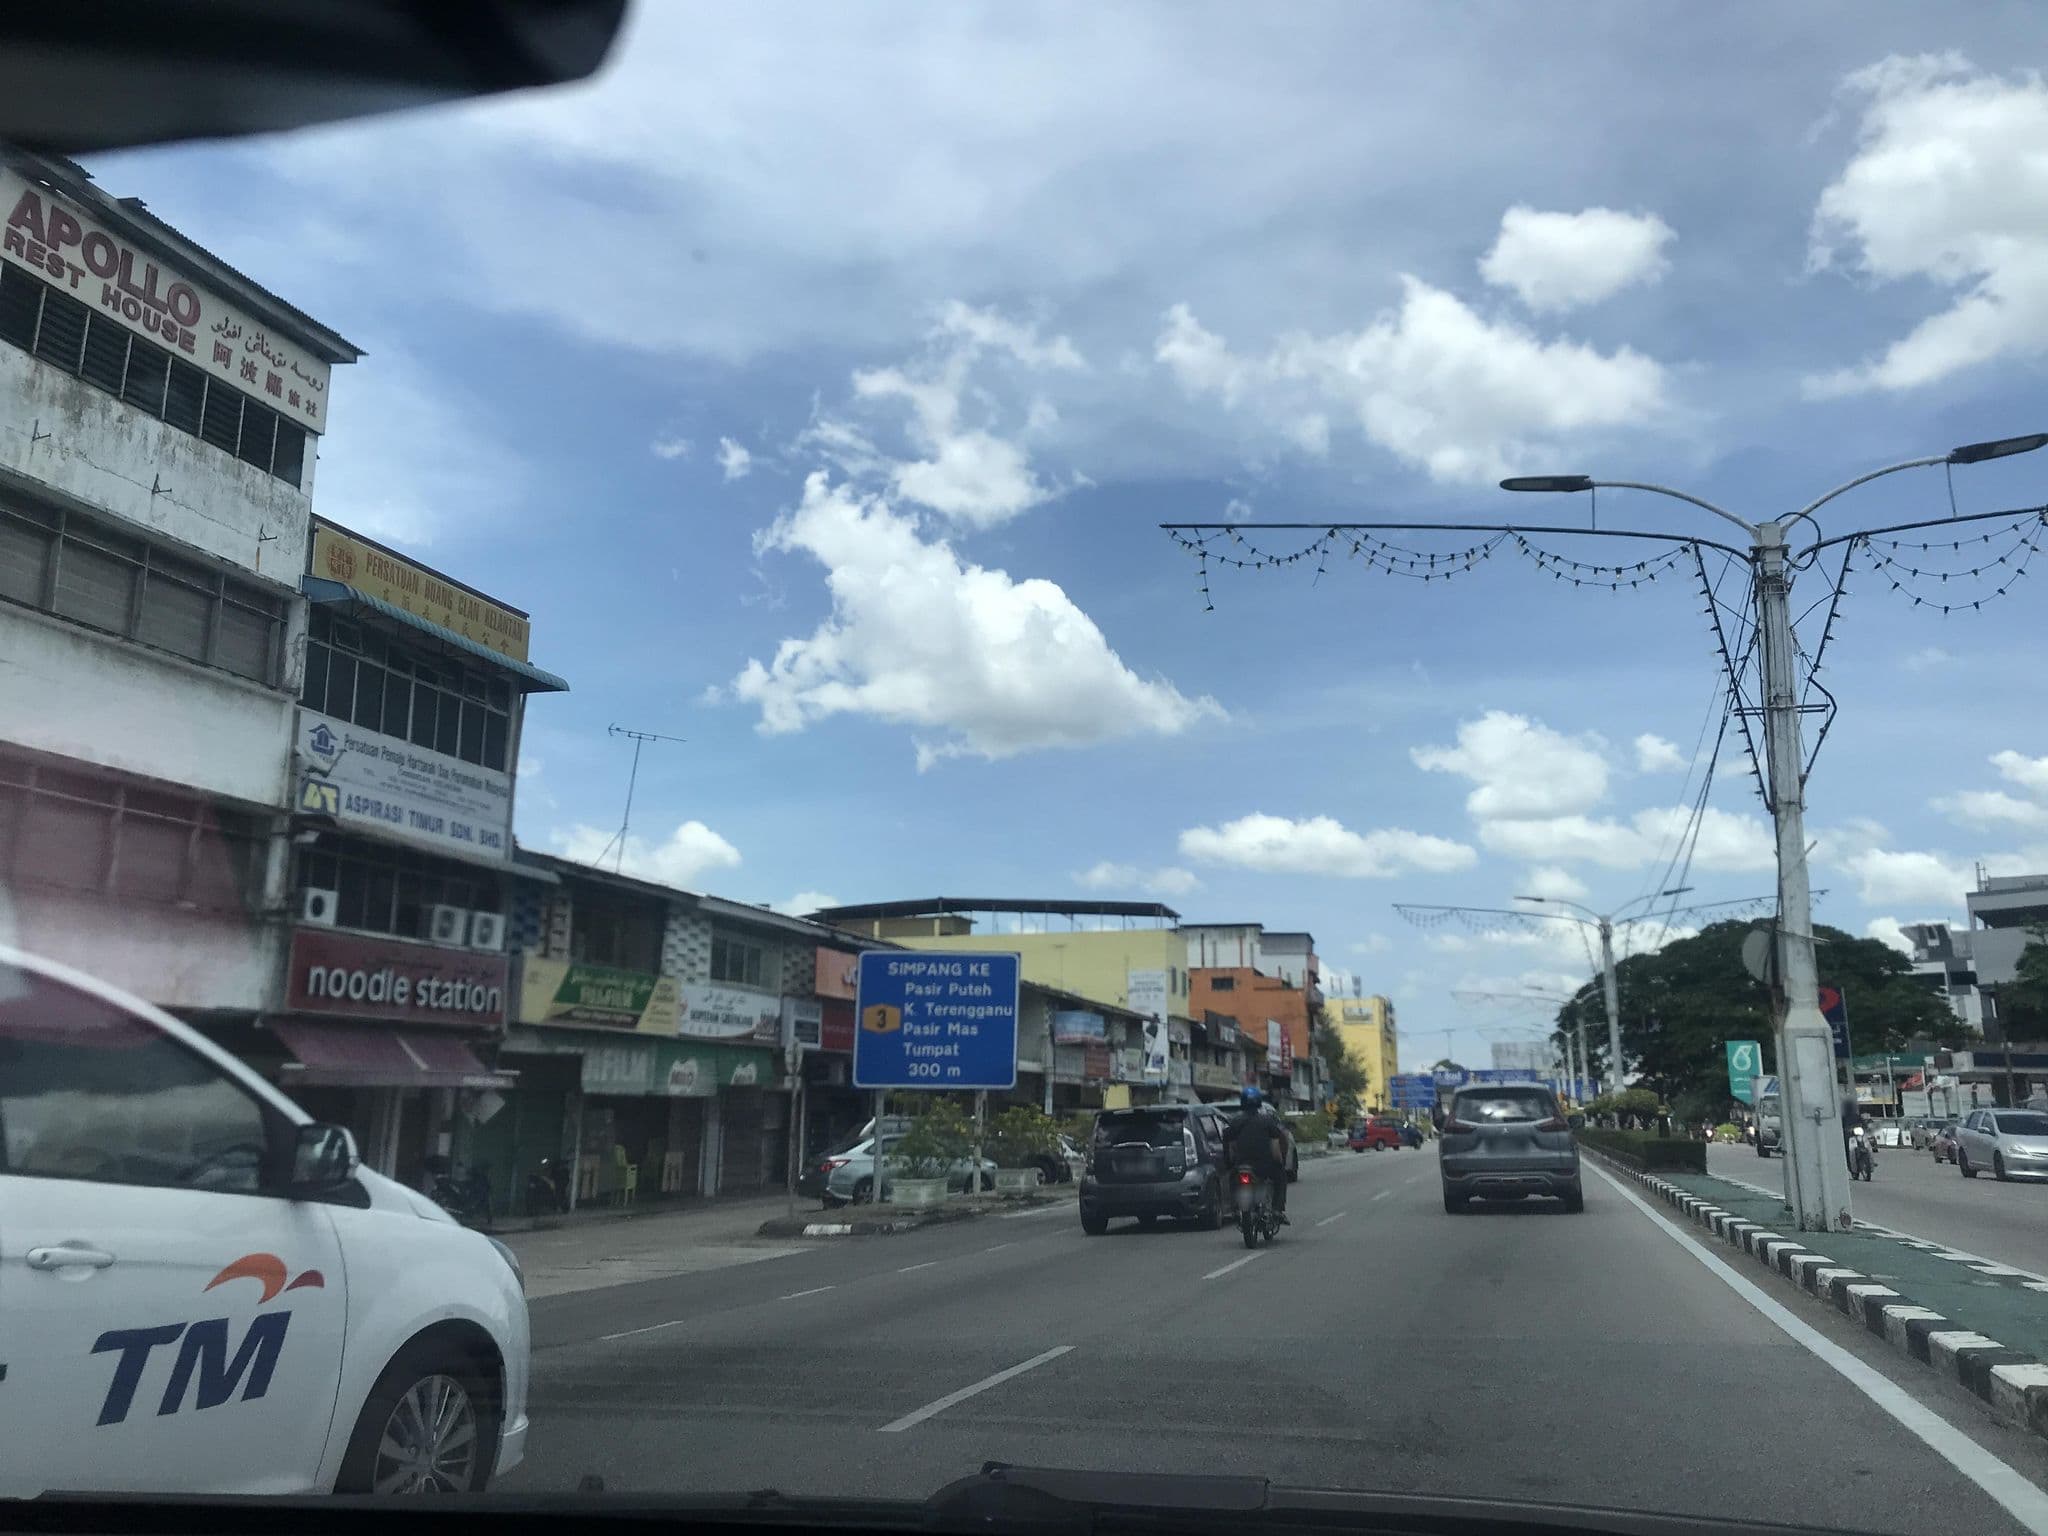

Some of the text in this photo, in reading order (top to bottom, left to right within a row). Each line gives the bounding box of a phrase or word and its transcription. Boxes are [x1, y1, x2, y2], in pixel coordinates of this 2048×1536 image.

[8, 190, 201, 328] APOLLO
[3, 226, 198, 355] REST HOUSE
[366, 552, 420, 595] PERSATUAN
[345, 793, 403, 824] ASPIRASI
[408, 808, 443, 833] TIMUR
[888, 962, 991, 977] SIMPANG KE
[308, 965, 500, 1014] noodle station
[905, 983, 992, 997] Pasir Puteh
[877, 1009, 886, 1029] 3
[925, 1002, 1014, 1019] Terengganu
[903, 1022, 979, 1036] Pasir Mas
[903, 1042, 960, 1058] Tumpat
[908, 1063, 961, 1077] 300 m
[91, 1310, 292, 1427] TM
